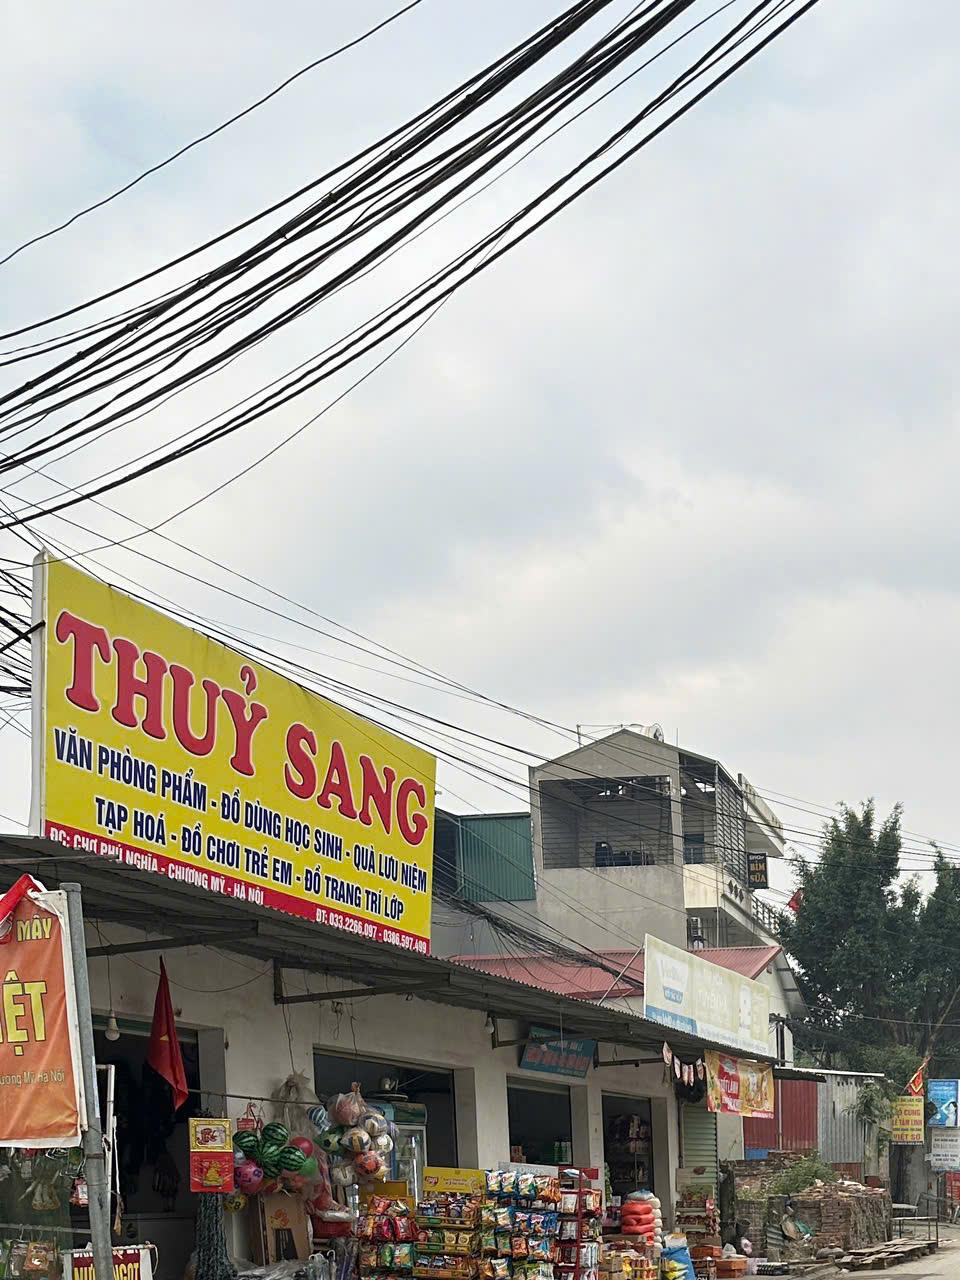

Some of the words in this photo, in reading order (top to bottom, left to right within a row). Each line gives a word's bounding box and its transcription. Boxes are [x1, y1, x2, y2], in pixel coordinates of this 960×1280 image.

[56, 611, 268, 777] THUỶ
[284, 723, 428, 846] SANG
[54, 727, 92, 771] VĂN
[98, 745, 156, 794] PHÒNG
[161, 768, 207, 812] PHẨM
[221, 789, 240, 824] ĐỒ
[244, 800, 281, 840] DÙNG
[285, 817, 310, 852] HỌC
[314, 828, 343, 861] SINH
[353, 844, 376, 874] QUÀ
[378, 854, 398, 882] LƯU
[401, 863, 427, 894] NIỆM
[95, 797, 128, 835] TẠP
[133, 810, 166, 846] HOÁ
[181, 823, 201, 857] ĐỒ
[206, 835, 240, 869] CHƠI
[244, 846, 268, 878] TRẺ
[272, 858, 292, 886] EM
[304, 864, 321, 895] ĐỒ
[325, 875, 361, 908] TRANG
[365, 889, 381, 915] TRÍ
[384, 895, 404, 921] LỚP
[17, 914, 52, 942] MÂY
